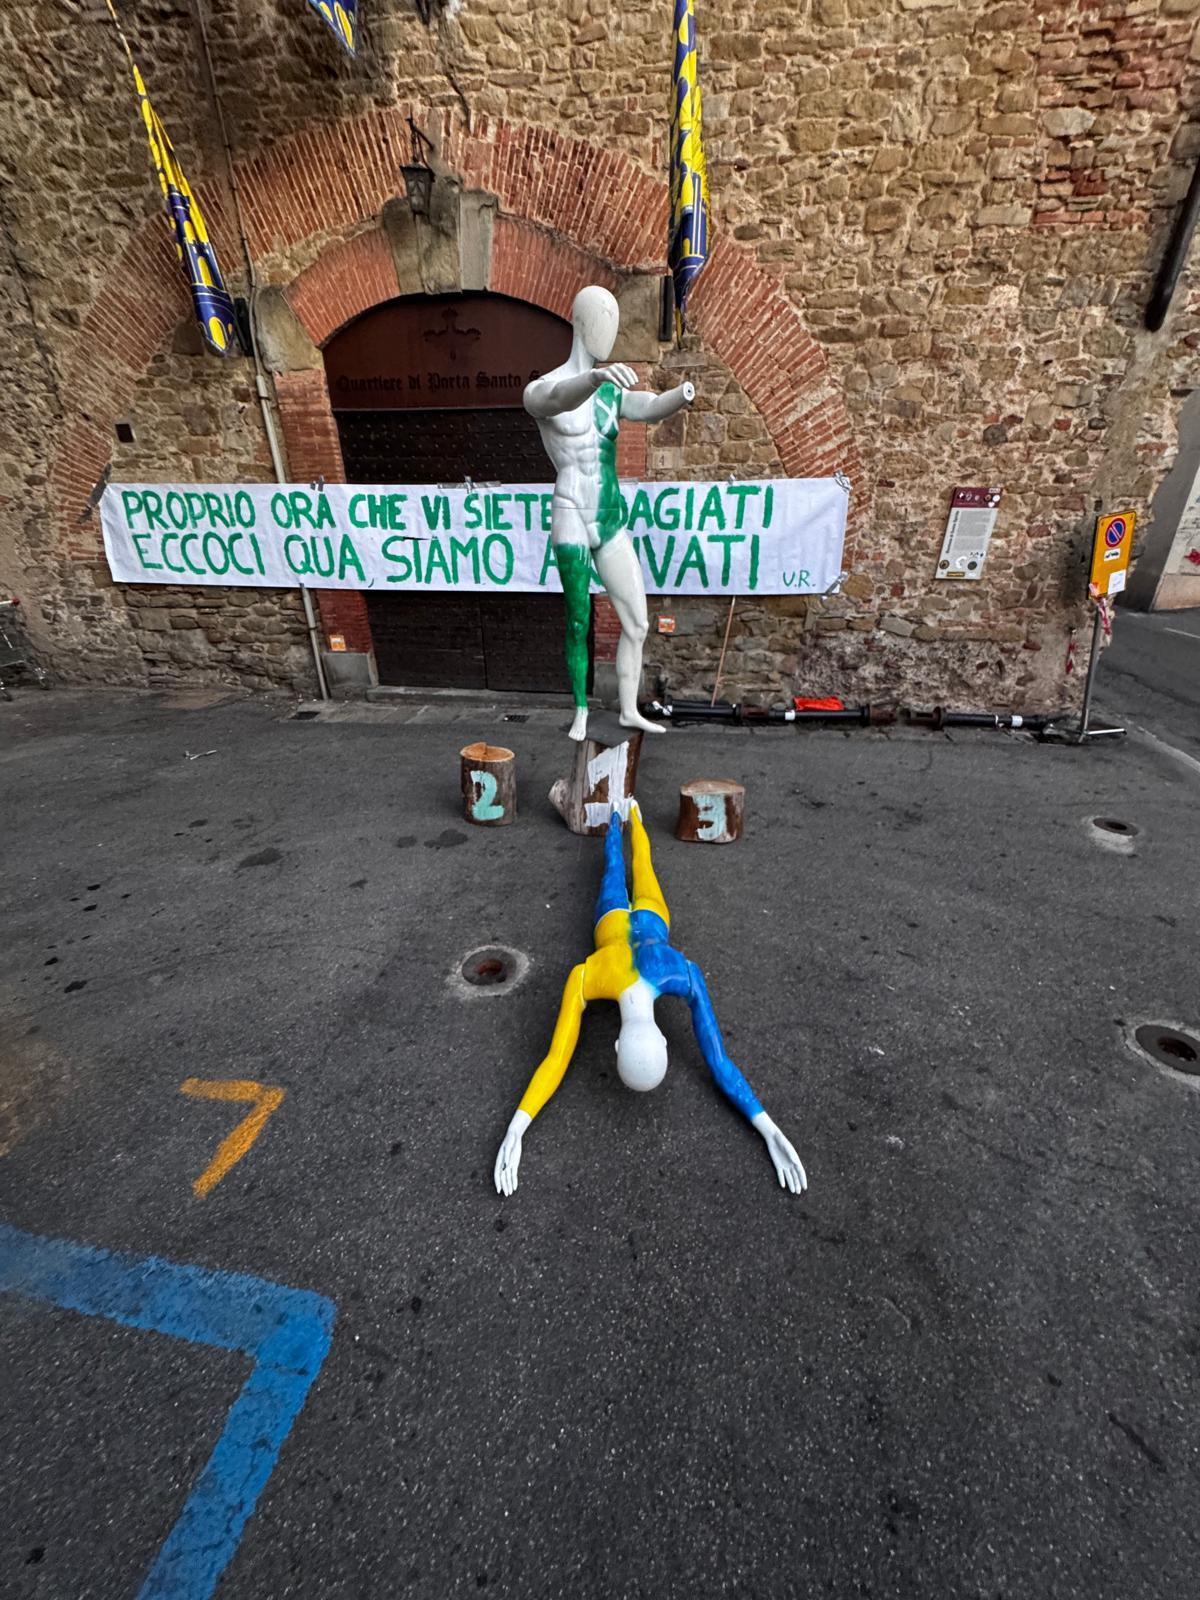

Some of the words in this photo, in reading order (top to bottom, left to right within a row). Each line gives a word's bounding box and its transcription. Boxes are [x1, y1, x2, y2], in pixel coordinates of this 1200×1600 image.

[336, 374, 403, 393] Quartiere
[408, 373, 421, 391] di
[428, 371, 471, 392] Porta
[475, 370, 522, 389] Santo
[121, 490, 256, 530] PROPRIO
[271, 490, 337, 529] ORA
[349, 493, 408, 531] CHE
[421, 494, 452, 531] VI
[464, 493, 555, 532] SIETE
[131, 532, 266, 576] ECCOCI
[470, 770, 505, 821] 2
[584, 741, 640, 827] 1
[692, 793, 728, 841] 3
